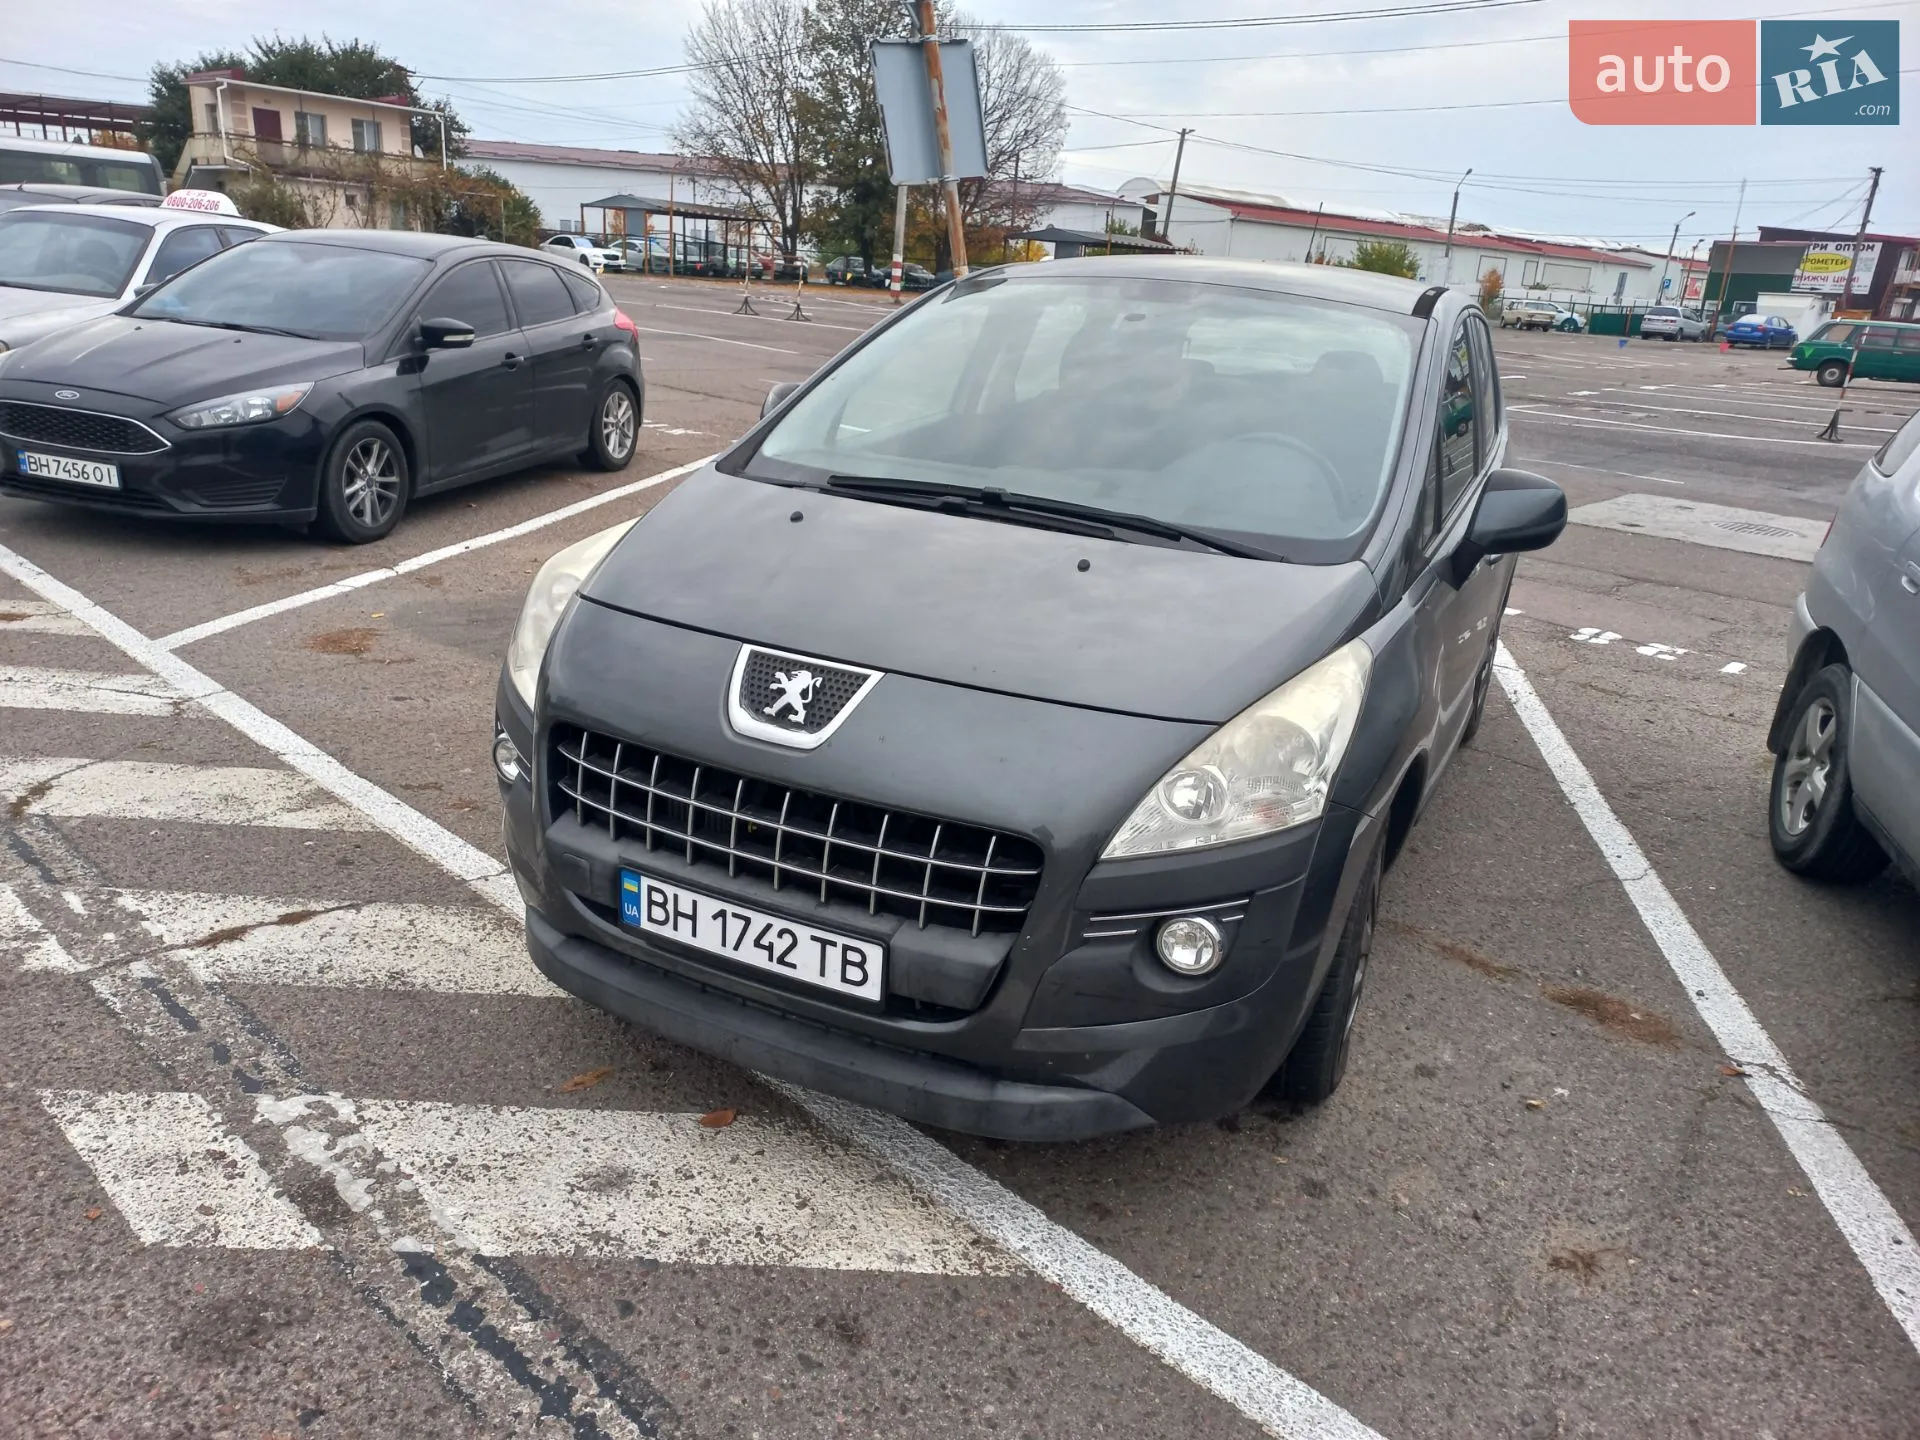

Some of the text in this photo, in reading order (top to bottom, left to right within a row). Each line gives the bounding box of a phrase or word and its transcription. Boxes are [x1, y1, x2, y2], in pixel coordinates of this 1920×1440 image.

[166, 196, 220, 211] 0800-206-206
[624, 902, 639, 918] UA
[646, 884, 869, 987] BH 1742 TB
